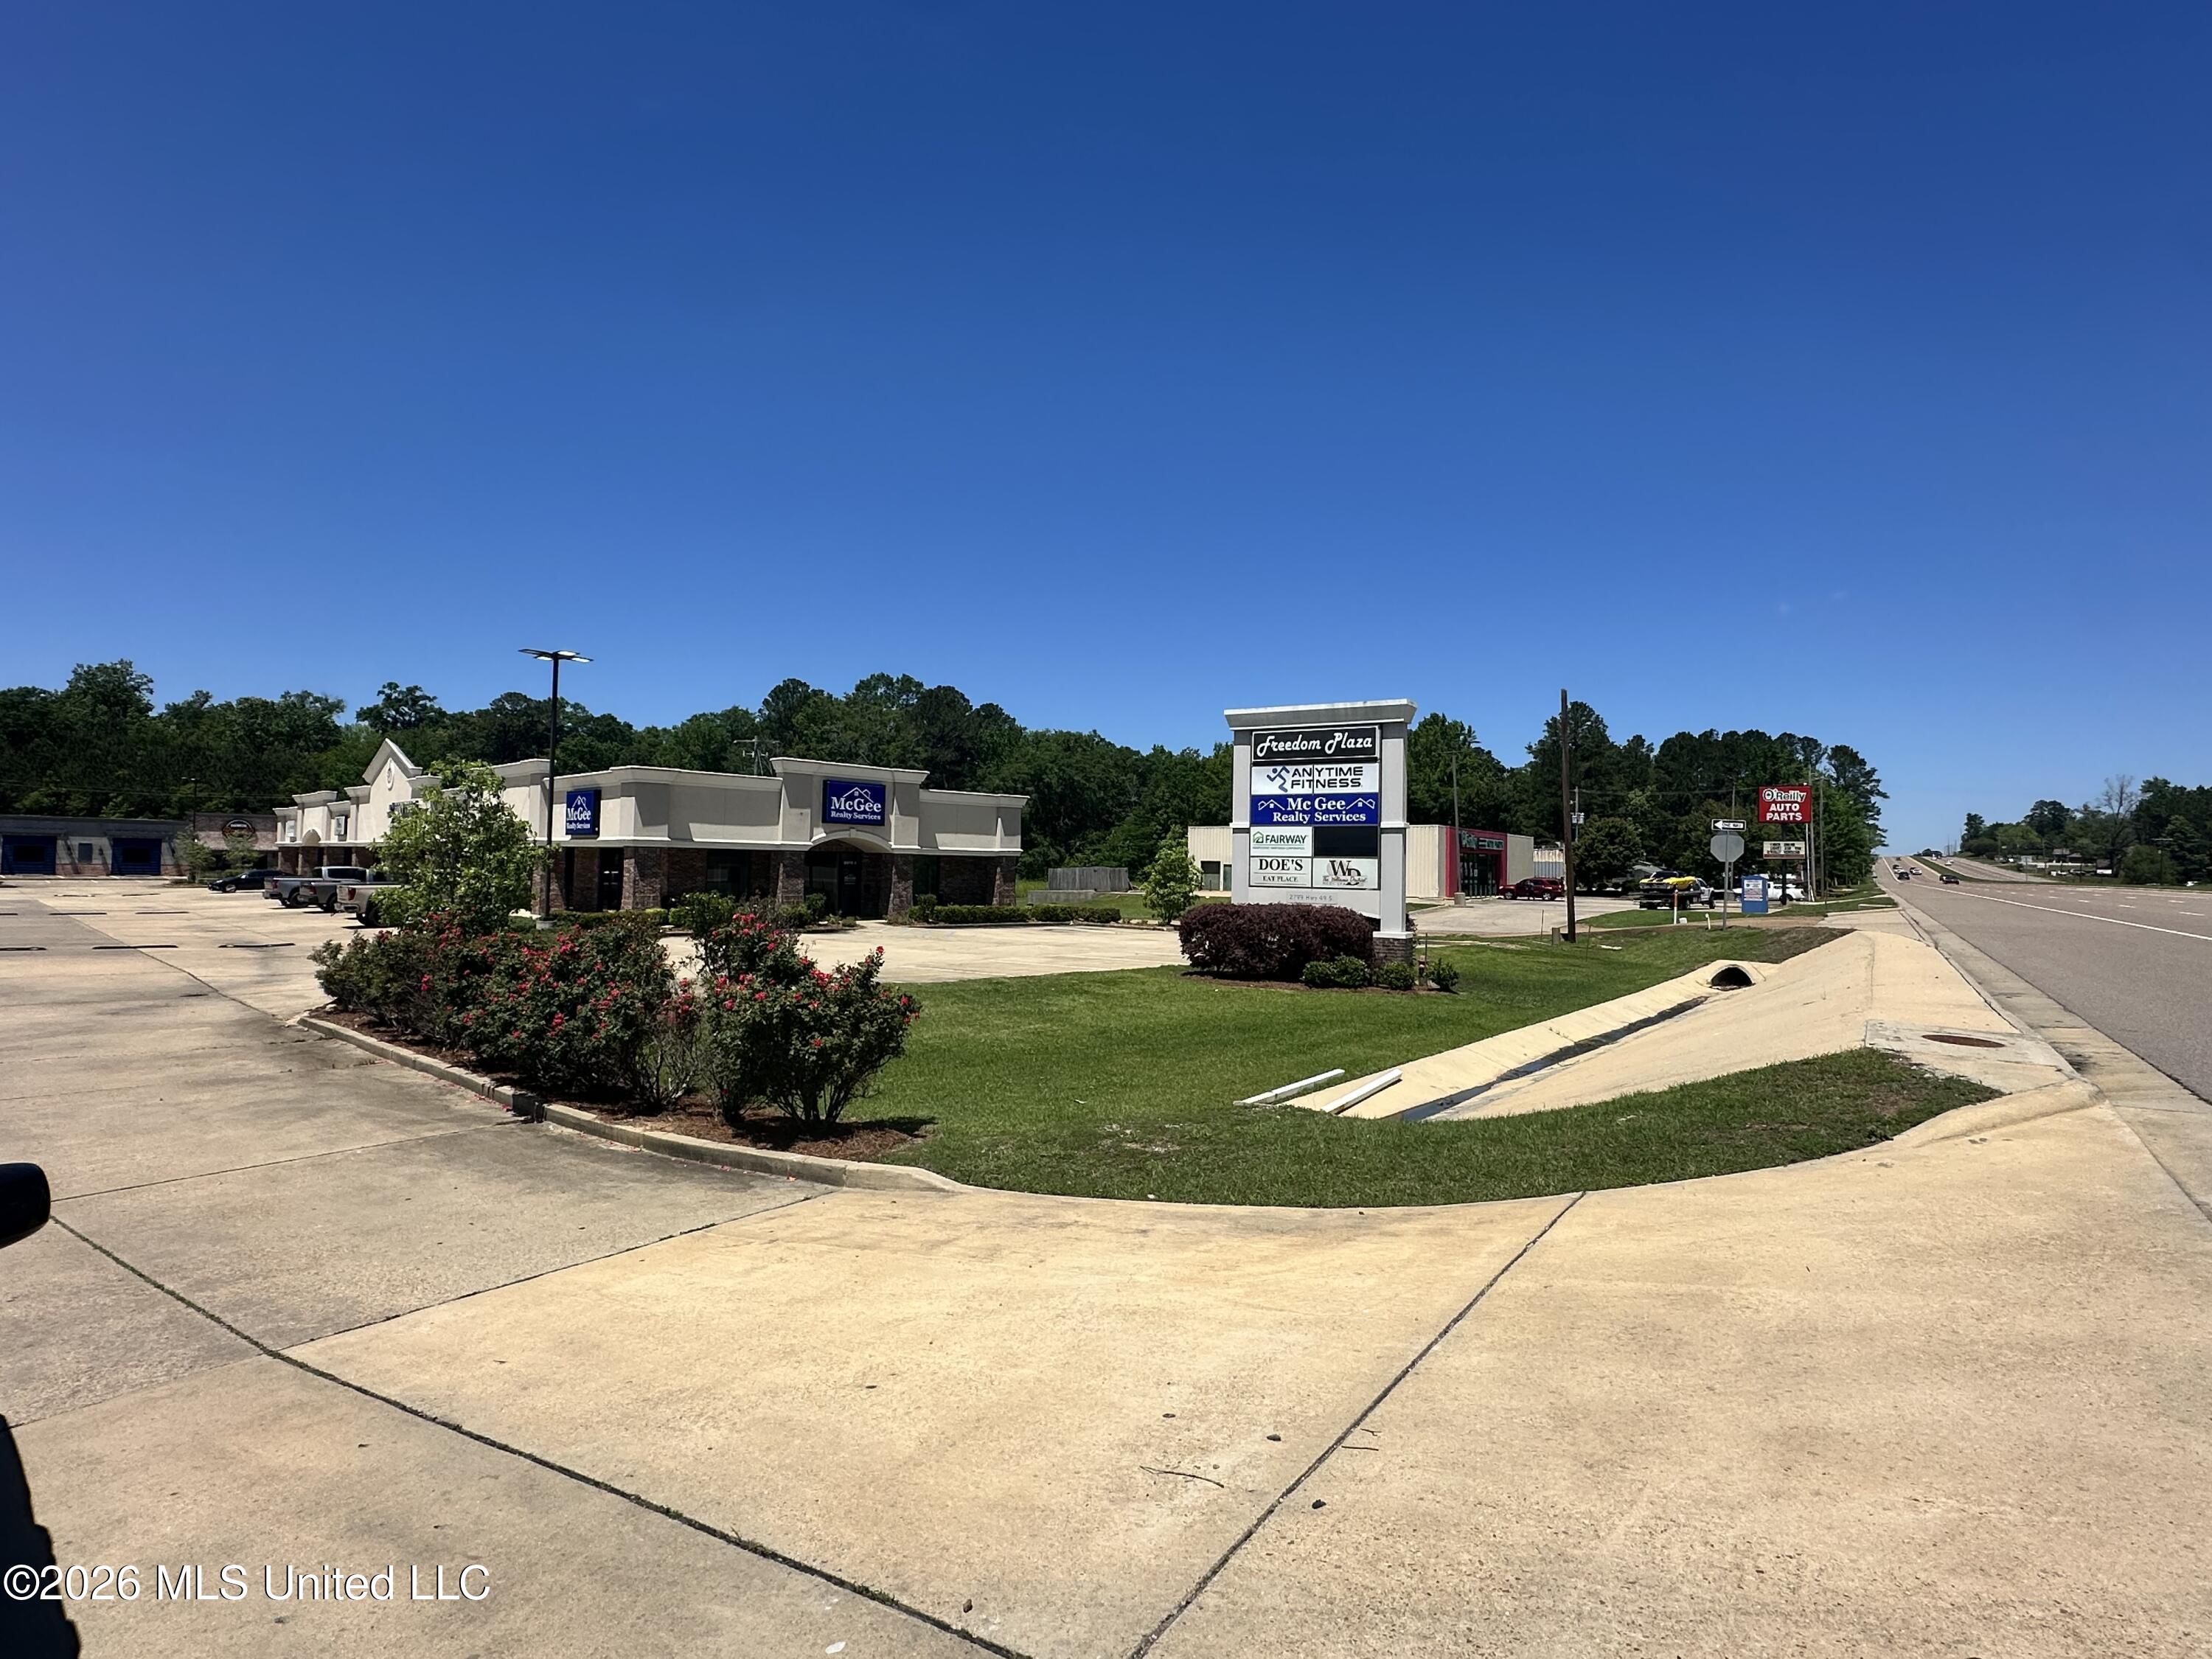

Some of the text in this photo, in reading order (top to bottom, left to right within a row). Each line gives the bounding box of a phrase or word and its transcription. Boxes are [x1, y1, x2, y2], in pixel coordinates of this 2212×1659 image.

[1256, 732, 1373, 757] Freedom Plaza
[1292, 766, 1363, 778] ANYTIME
[1291, 778, 1361, 789] FITNESS
[1763, 788, 1806, 802] O'Reilly
[830, 796, 882, 813] McGee
[1770, 803, 1800, 811] AUTO
[567, 807, 591, 821] McGee
[831, 811, 853, 819] Realty
[1273, 812, 1366, 824] Realty Services
[1766, 813, 1803, 821] PARTS
[1265, 835, 1307, 844] FAIRWAY
[1259, 858, 1303, 872] DOE'S
